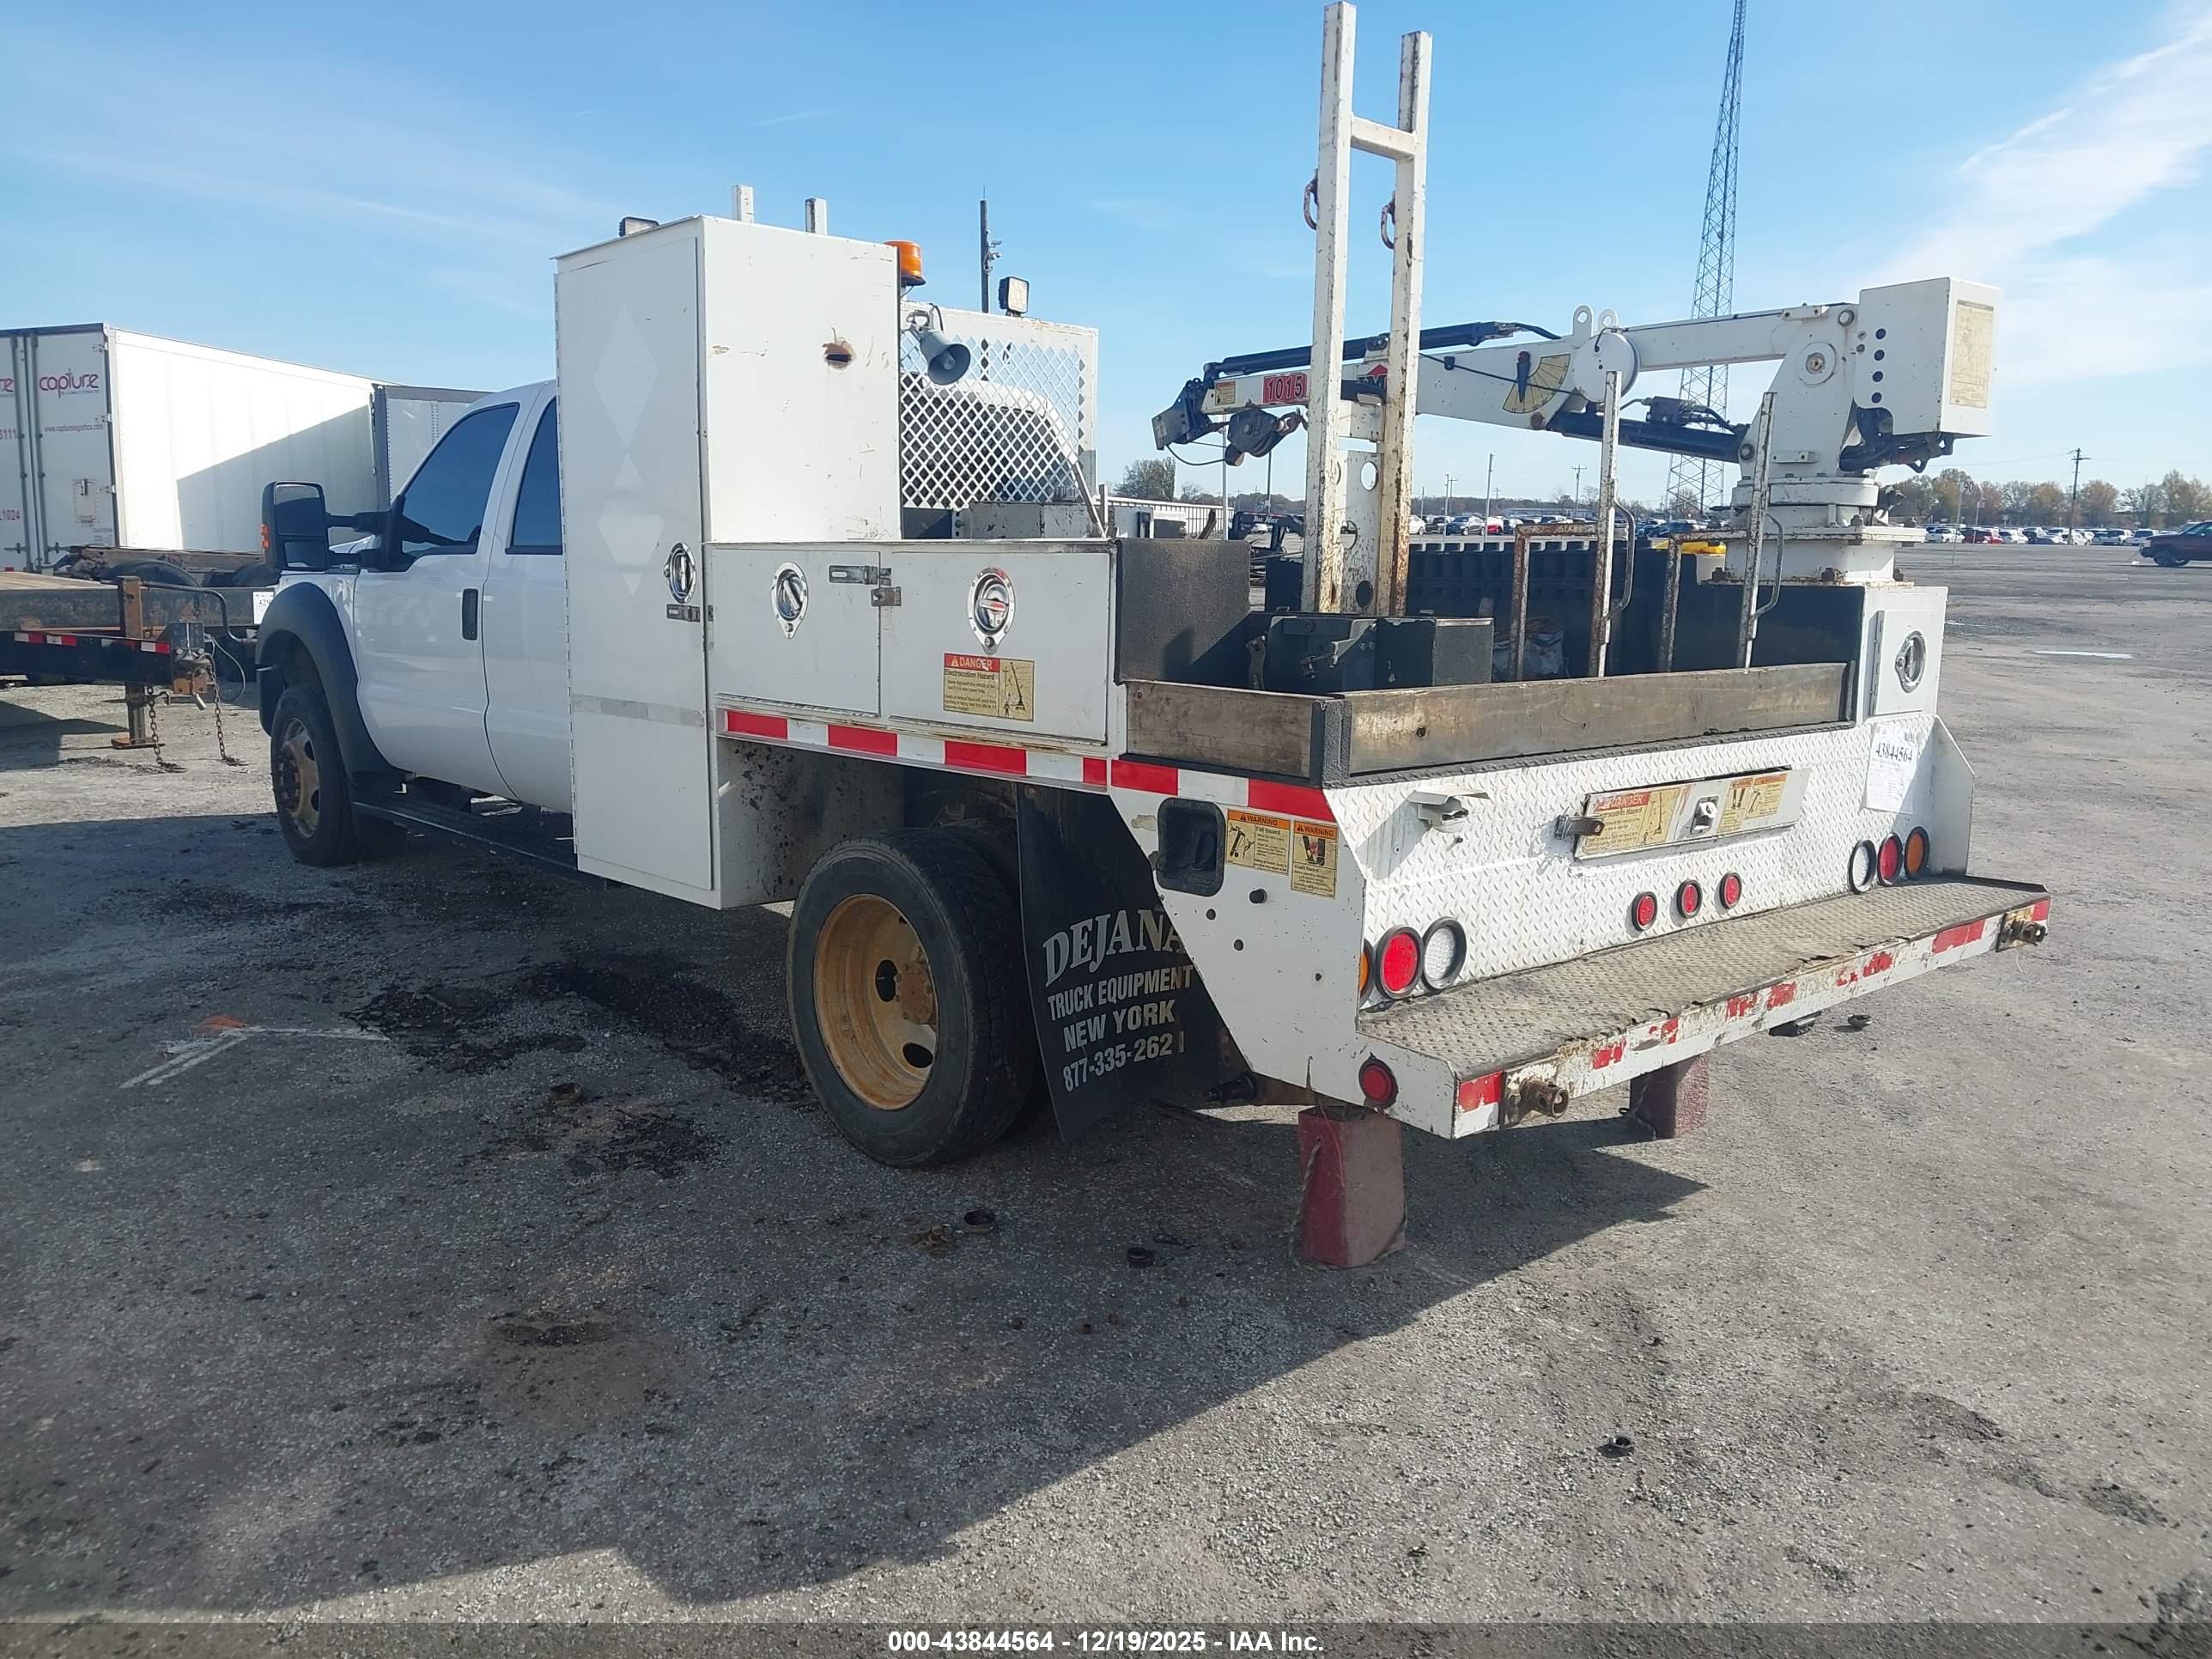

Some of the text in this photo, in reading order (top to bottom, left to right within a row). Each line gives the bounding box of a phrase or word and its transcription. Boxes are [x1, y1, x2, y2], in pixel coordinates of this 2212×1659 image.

[40, 368, 100, 398] capture
[1267, 373, 1306, 401] 1015
[959, 656, 994, 671] DANGER
[1875, 742, 1913, 763] 43844564
[1613, 793, 1644, 807] DANGER
[1247, 815, 1279, 826] WARNING
[1304, 825, 1334, 836] WARNING
[1042, 908, 1187, 986] DEJANA
[1048, 964, 1194, 1021] TRUCK EQUIPMENT
[1063, 999, 1176, 1053] NEW YORK
[1063, 1030, 1184, 1091] 877-335-2621
